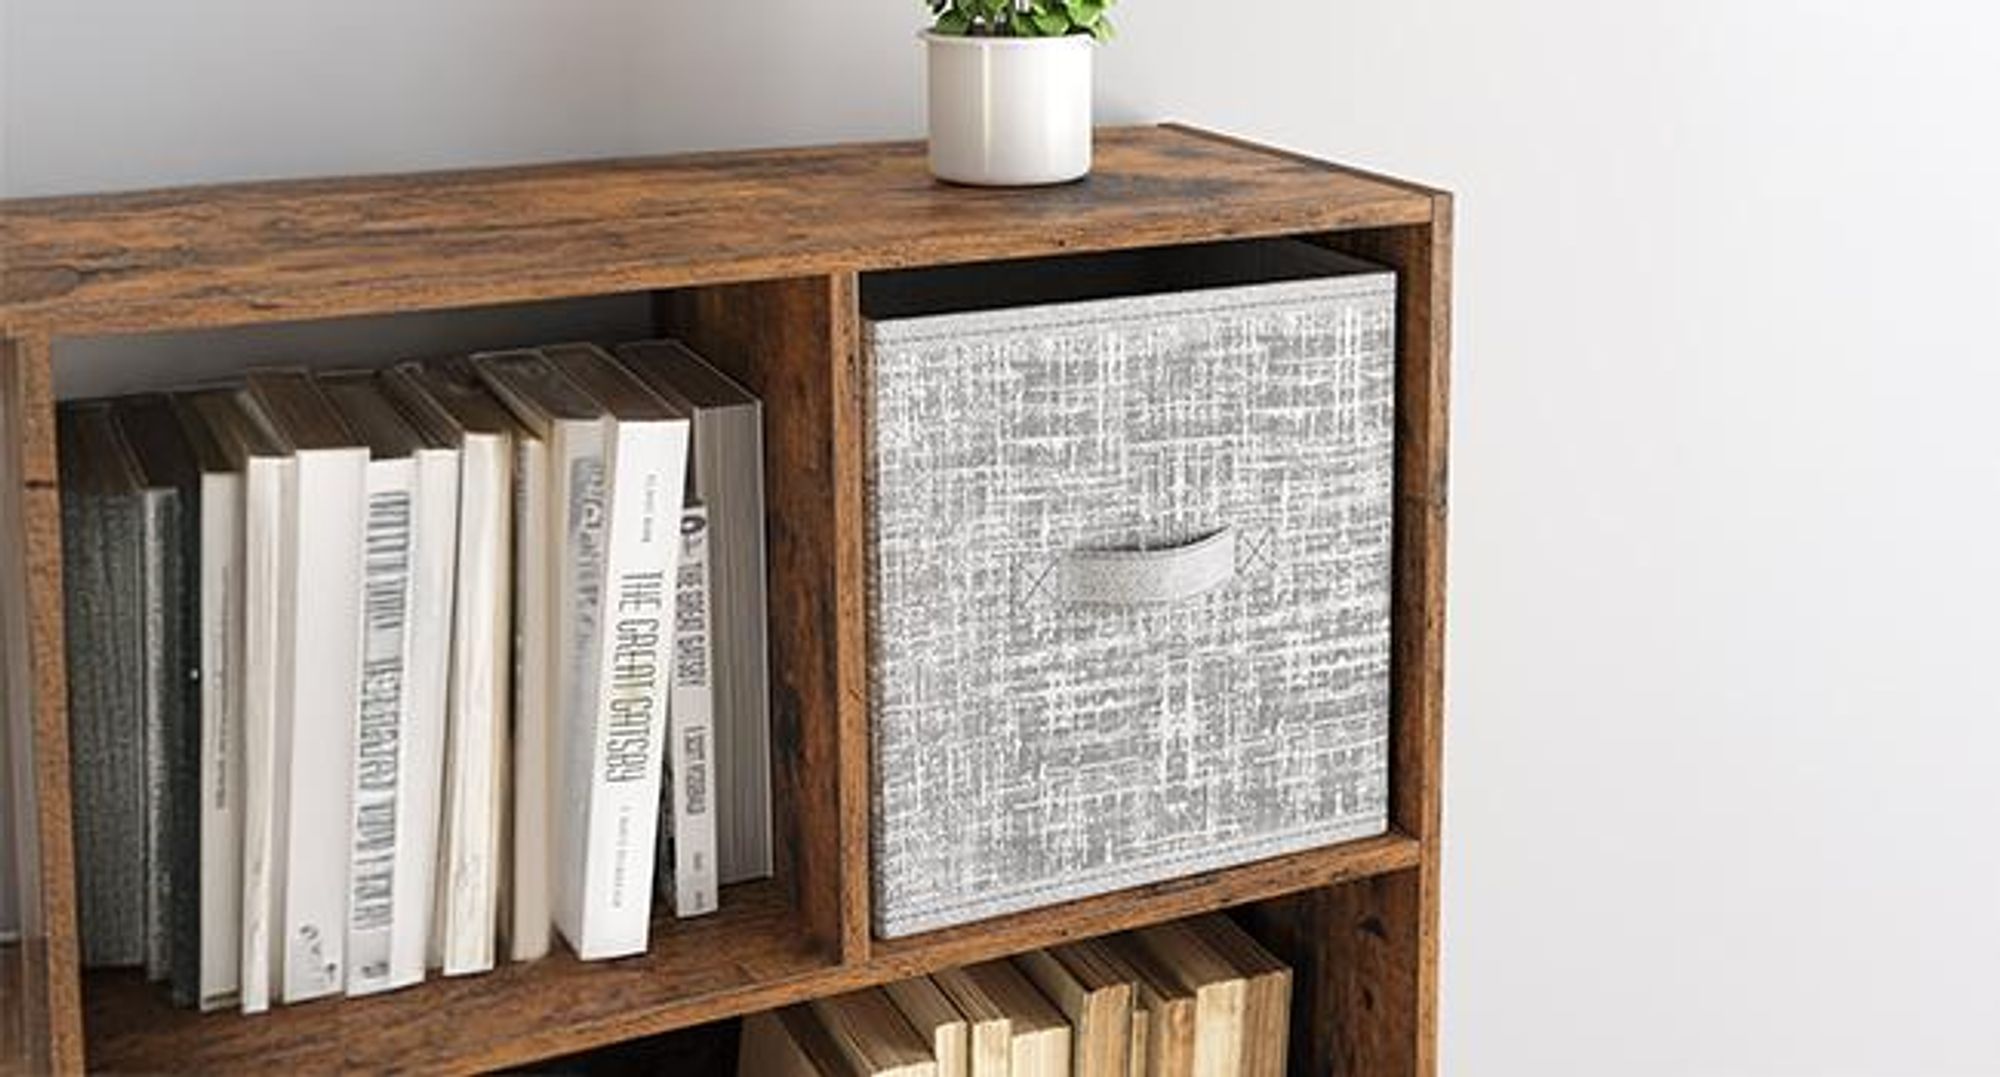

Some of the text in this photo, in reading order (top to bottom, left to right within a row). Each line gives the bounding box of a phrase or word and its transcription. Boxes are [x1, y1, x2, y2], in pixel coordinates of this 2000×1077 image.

[620, 570, 663, 612] THE
[612, 618, 659, 688] GREAT
[605, 696, 653, 782] GATSBY
